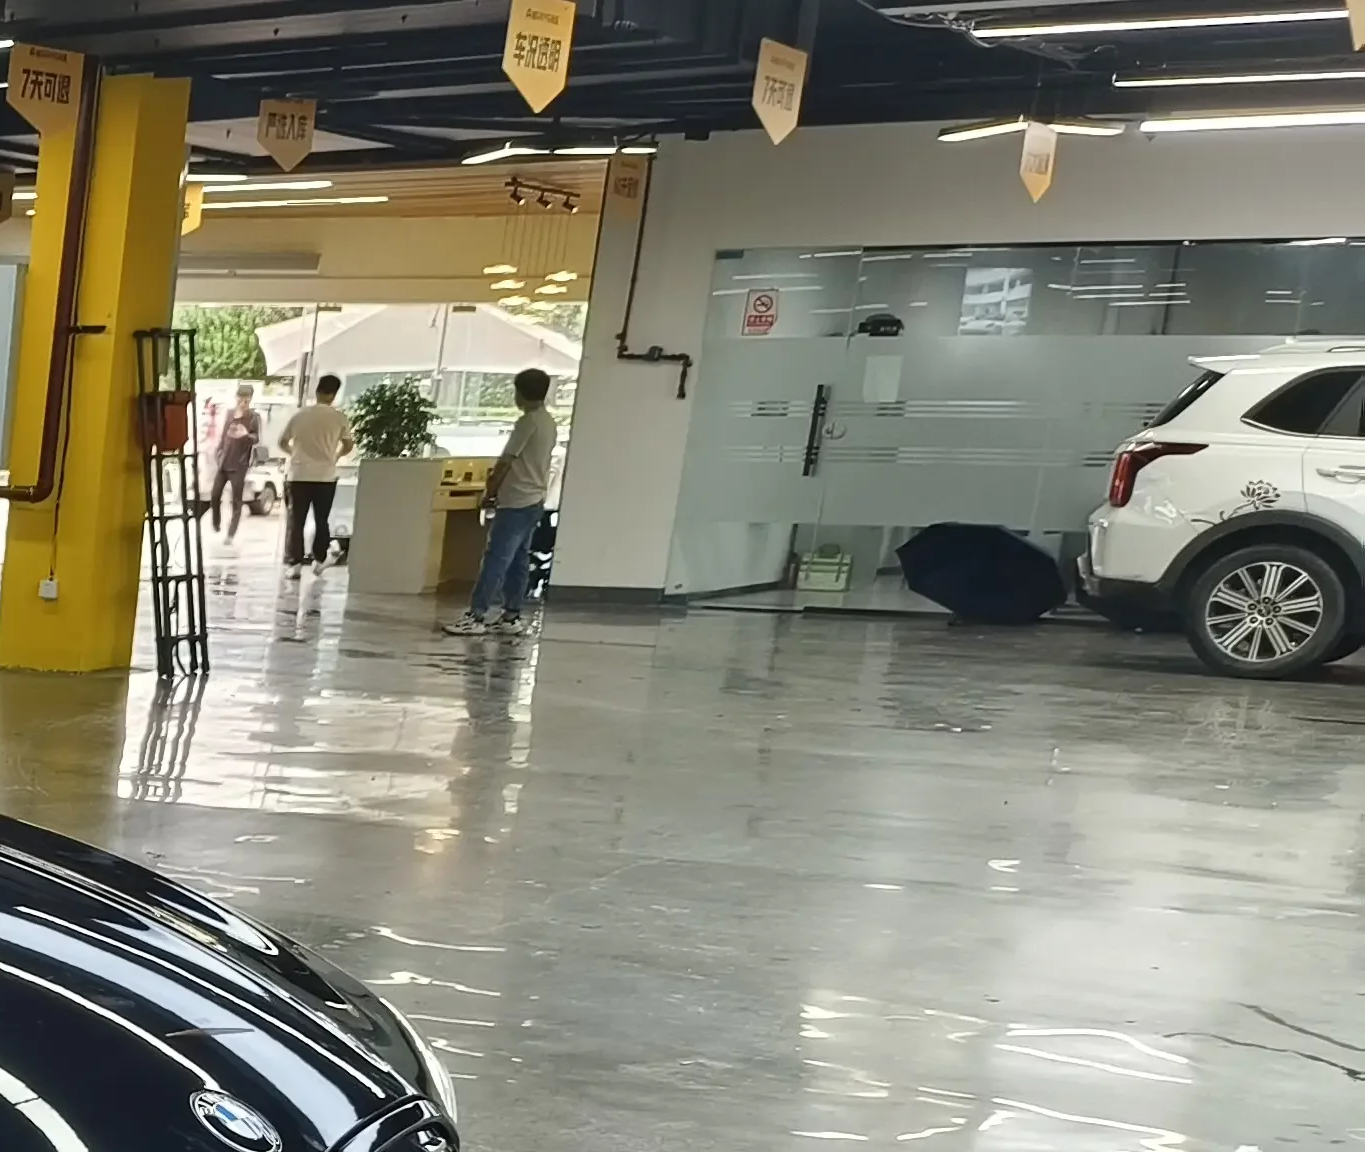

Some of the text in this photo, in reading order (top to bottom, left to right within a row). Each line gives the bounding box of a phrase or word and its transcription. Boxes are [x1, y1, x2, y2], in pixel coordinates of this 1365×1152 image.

[513, 31, 562, 72] 车况透明
[20, 68, 71, 105] 7天可退
